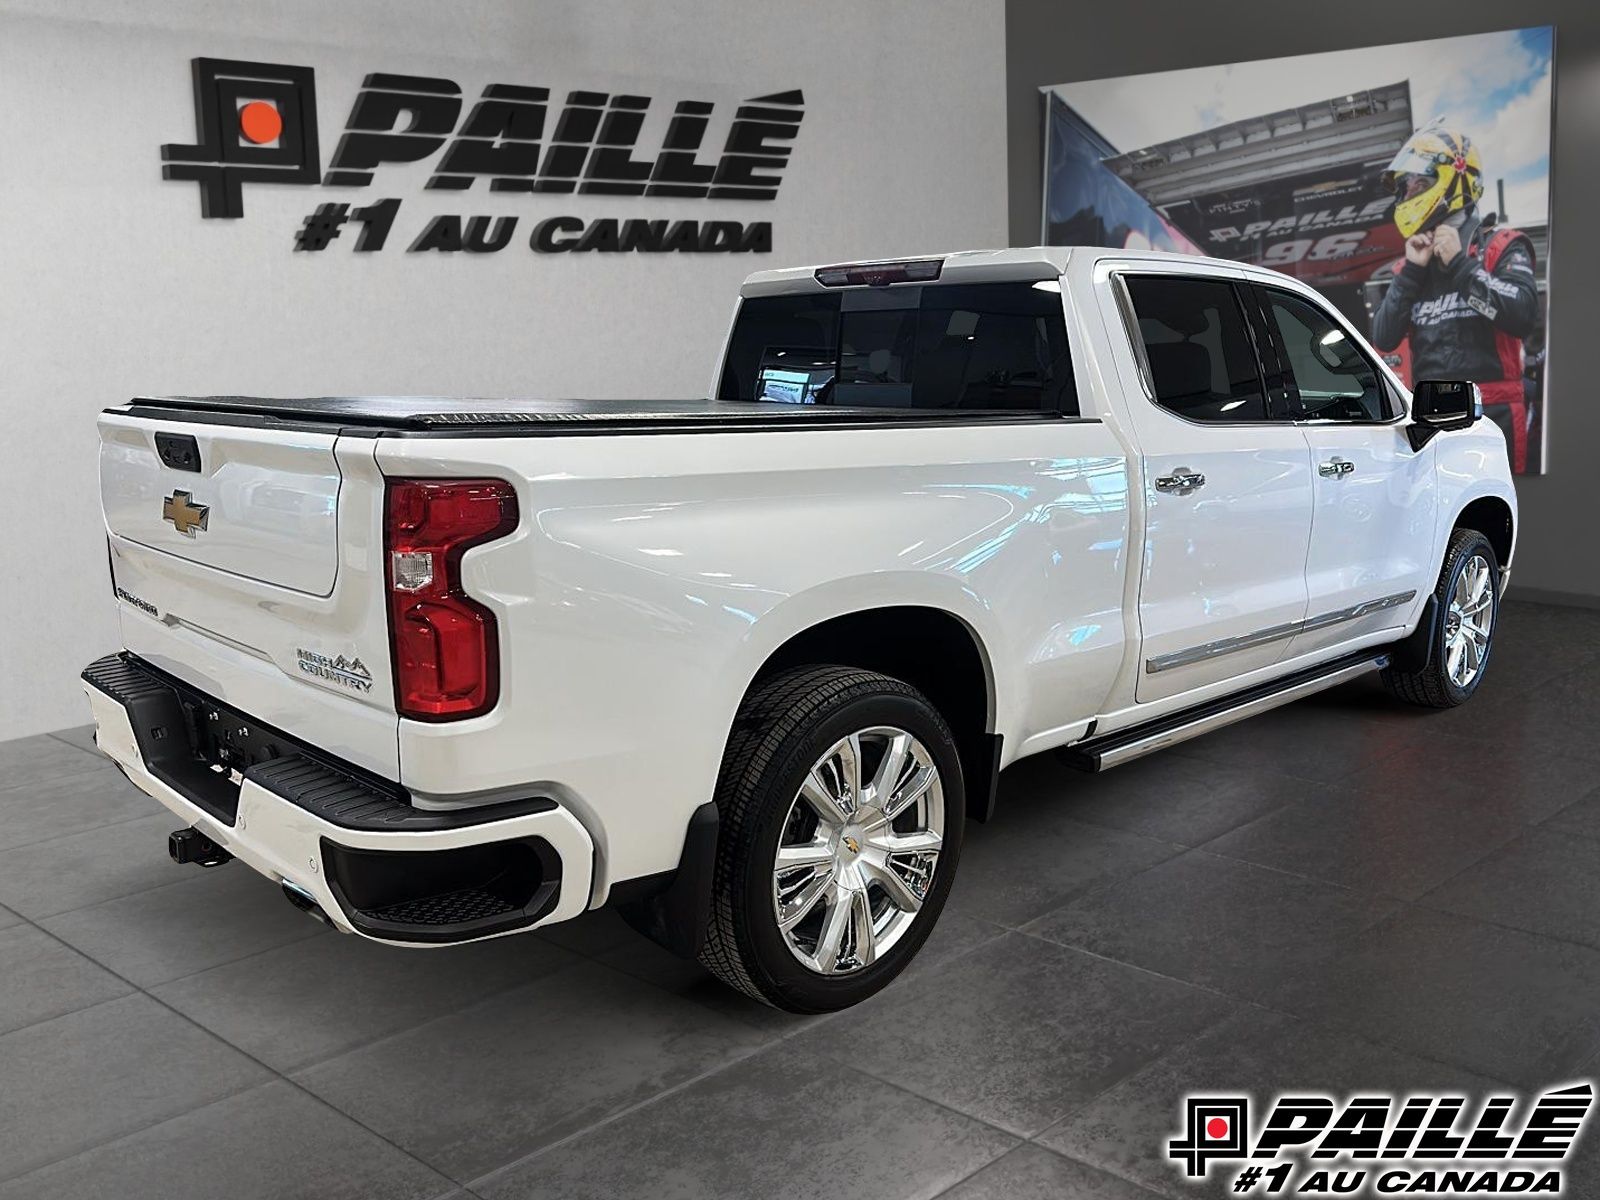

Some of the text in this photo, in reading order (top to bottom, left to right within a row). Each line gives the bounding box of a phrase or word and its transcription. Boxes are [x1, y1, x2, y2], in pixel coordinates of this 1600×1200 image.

[293, 198, 772, 253] #1 AU CANADA
[1261, 230, 1369, 266] 96
[296, 648, 334, 668] HIGH
[298, 659, 373, 693] COUNTRY
